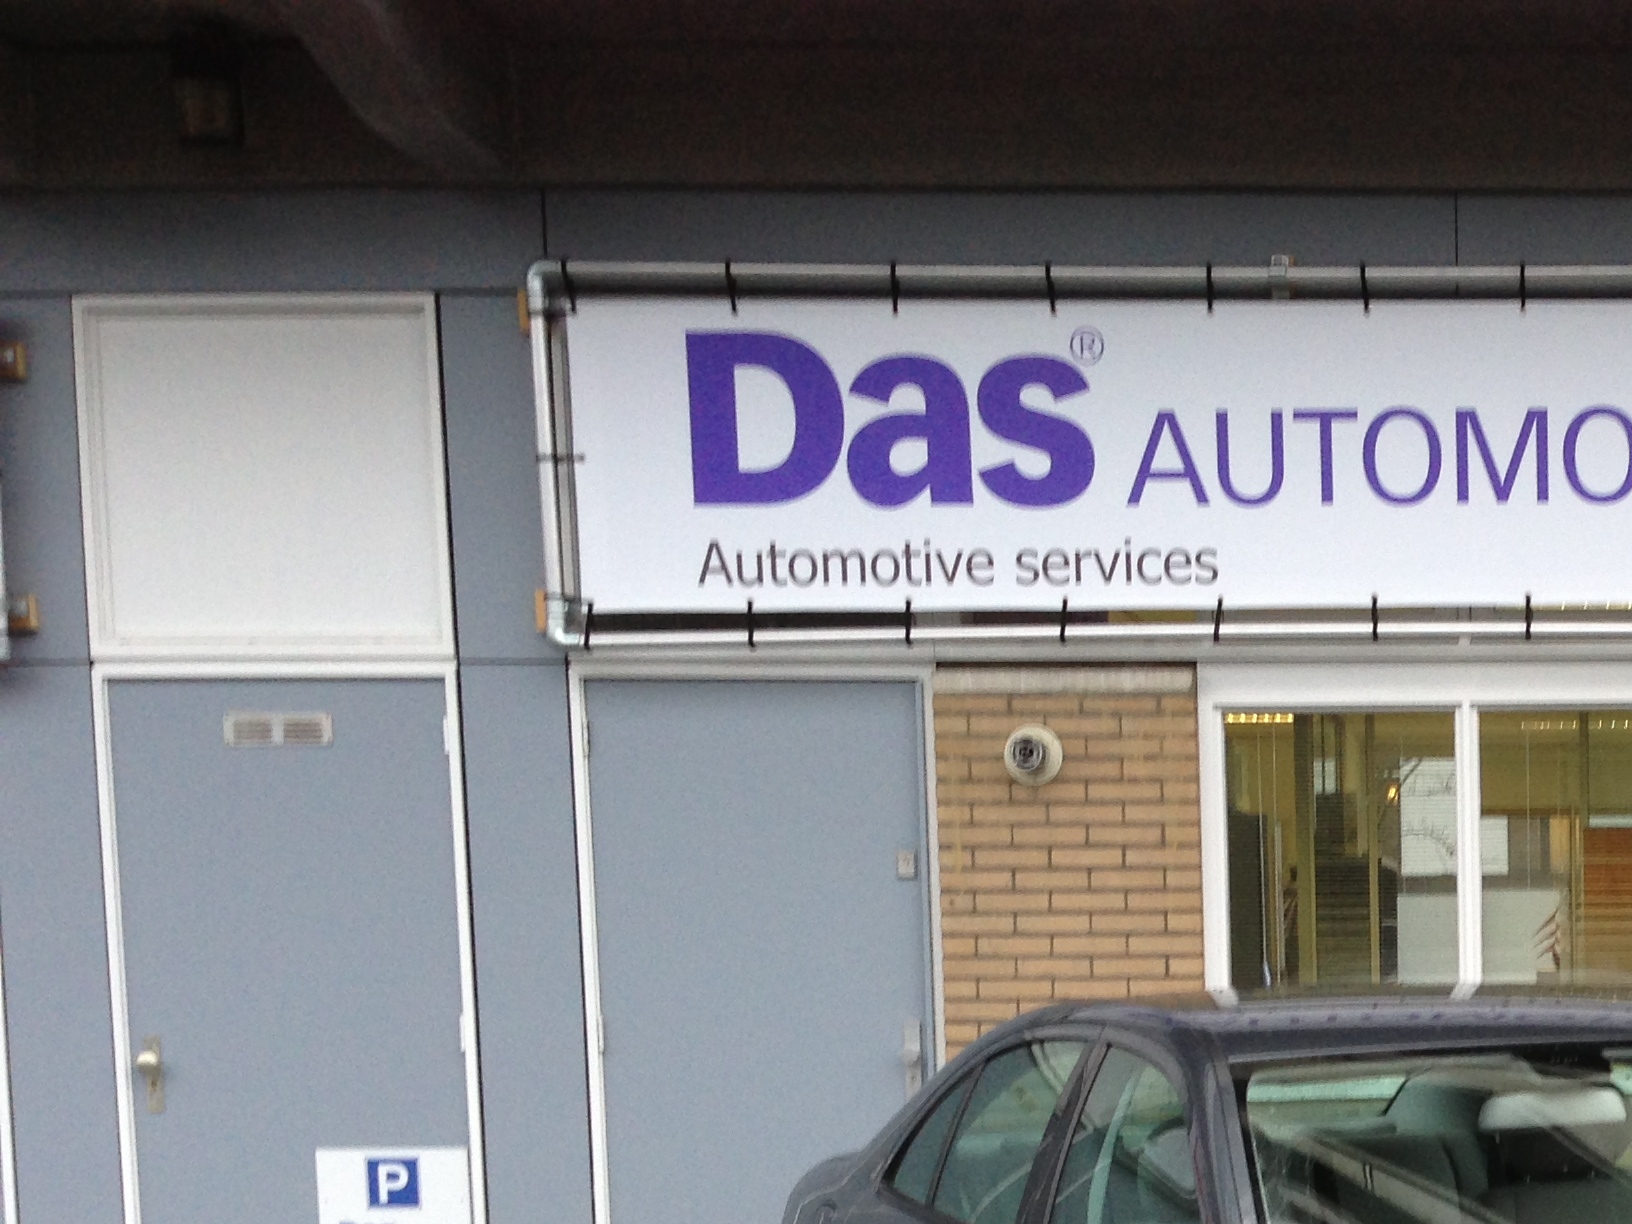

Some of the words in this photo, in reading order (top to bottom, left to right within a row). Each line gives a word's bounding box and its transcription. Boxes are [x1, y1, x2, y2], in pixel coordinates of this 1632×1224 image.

[698, 536, 995, 588] Automotive
[1014, 536, 1219, 587] services
[377, 1162, 409, 1204] P
